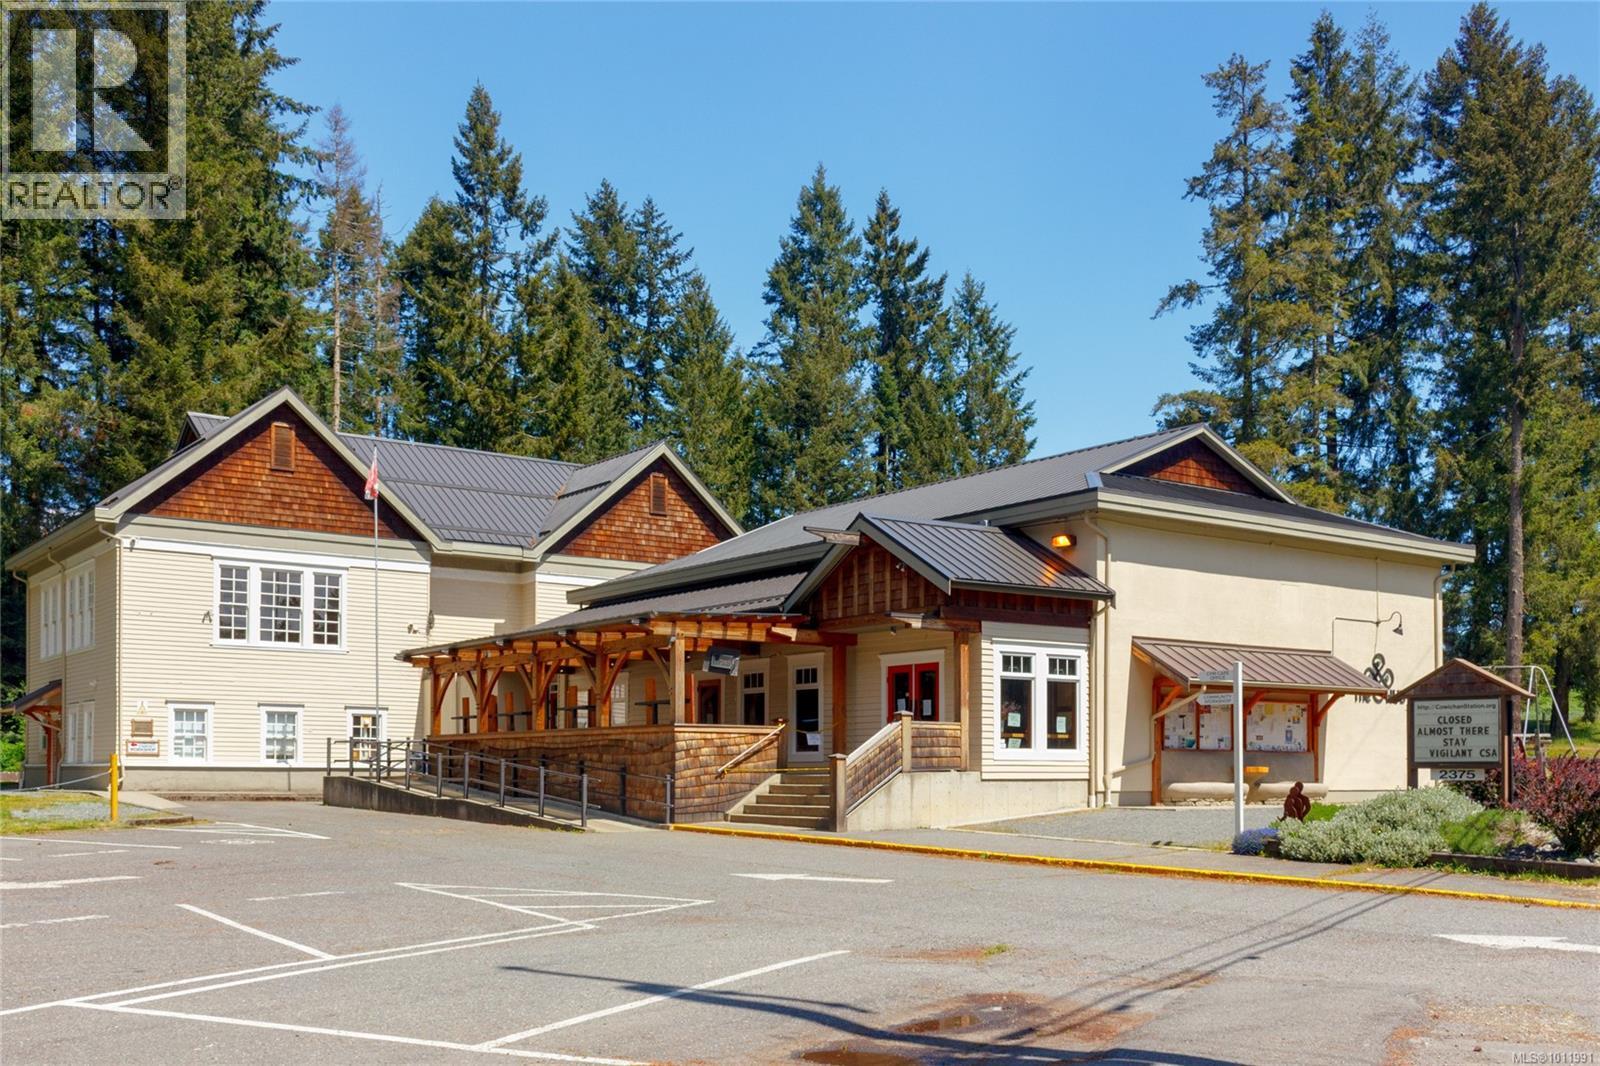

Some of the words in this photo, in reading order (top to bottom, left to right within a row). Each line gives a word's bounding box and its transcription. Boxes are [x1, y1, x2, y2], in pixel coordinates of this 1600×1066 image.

[1437, 715, 1472, 724] CLOSED
[1417, 726, 1453, 736] ALMOST
[1460, 726, 1490, 735] THERE
[1443, 738, 1467, 747] STAY
[1429, 749, 1472, 758] VIGILANT
[1479, 748, 1497, 758] CSA
[1440, 769, 1476, 779] 2375
